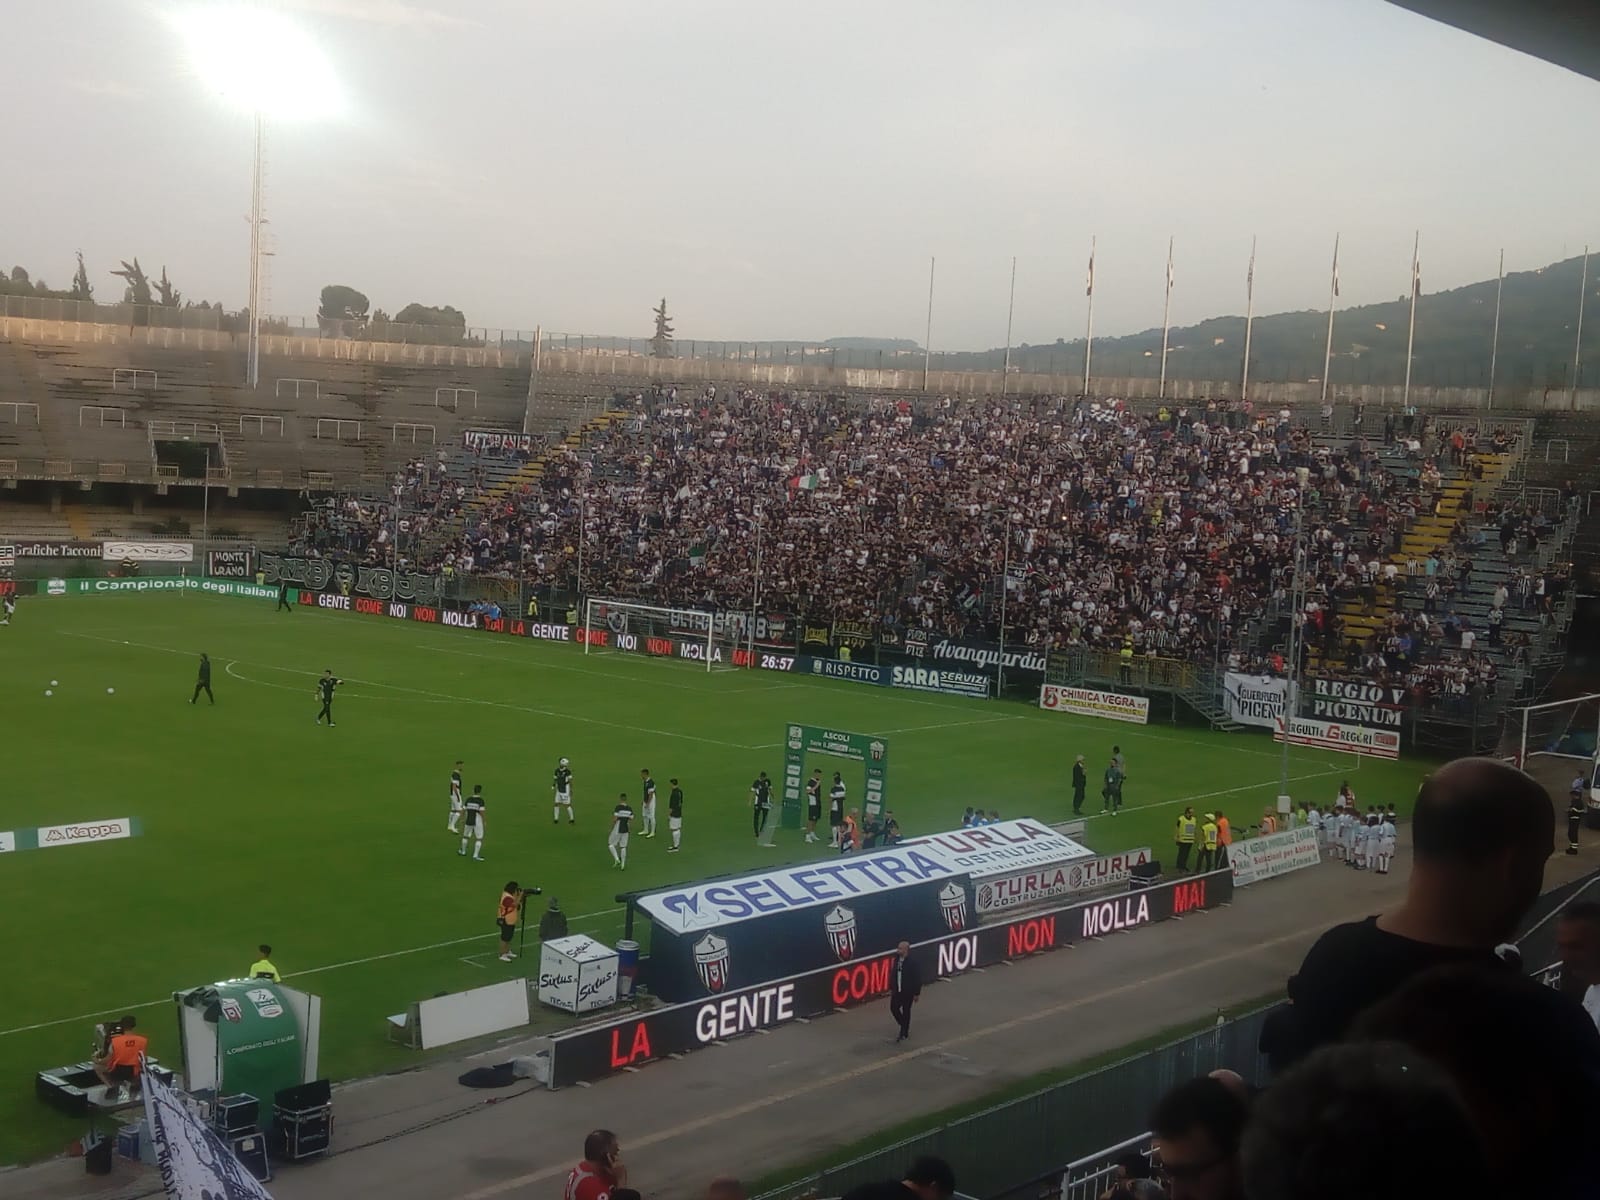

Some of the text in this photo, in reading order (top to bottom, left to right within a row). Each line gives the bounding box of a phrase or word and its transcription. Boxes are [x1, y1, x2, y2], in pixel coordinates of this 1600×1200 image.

[15, 544, 101, 557] Grafiche Tacconi
[216, 552, 245, 561] MONTE
[95, 578, 198, 592] Campionato
[202, 582, 233, 594] degli
[301, 592, 312, 605] LA
[319, 593, 349, 610] GENTE
[356, 598, 383, 615] COME
[389, 603, 406, 618] NOI
[414, 607, 436, 622] NON
[442, 611, 477, 628] MOLLA
[510, 621, 525, 635] LA
[532, 623, 569, 641] GENTE
[617, 634, 637, 650] NOI
[647, 637, 672, 656] NON
[732, 648, 755, 667] MAI
[761, 655, 795, 671] 26:57
[933, 639, 1046, 672] Avanguardia
[826, 660, 880, 682] RISPETTO
[893, 666, 988, 688] SARA SERVIZI
[1061, 689, 1100, 703] CHIMICA
[1102, 693, 1136, 708] VEGRA
[1315, 679, 1405, 705] REGIO V
[1314, 700, 1402, 726] PICENUM
[823, 731, 850, 742] ASCOLI
[66, 824, 121, 840] Kappa
[1084, 852, 1147, 879] TURLA
[704, 850, 953, 919] SELETTRA
[994, 869, 1066, 898] TURLA
[993, 886, 1066, 907] COSTRUZIONI
[610, 879, 1206, 1067] LA GENTE COM NOI NON MOLLA MAI
